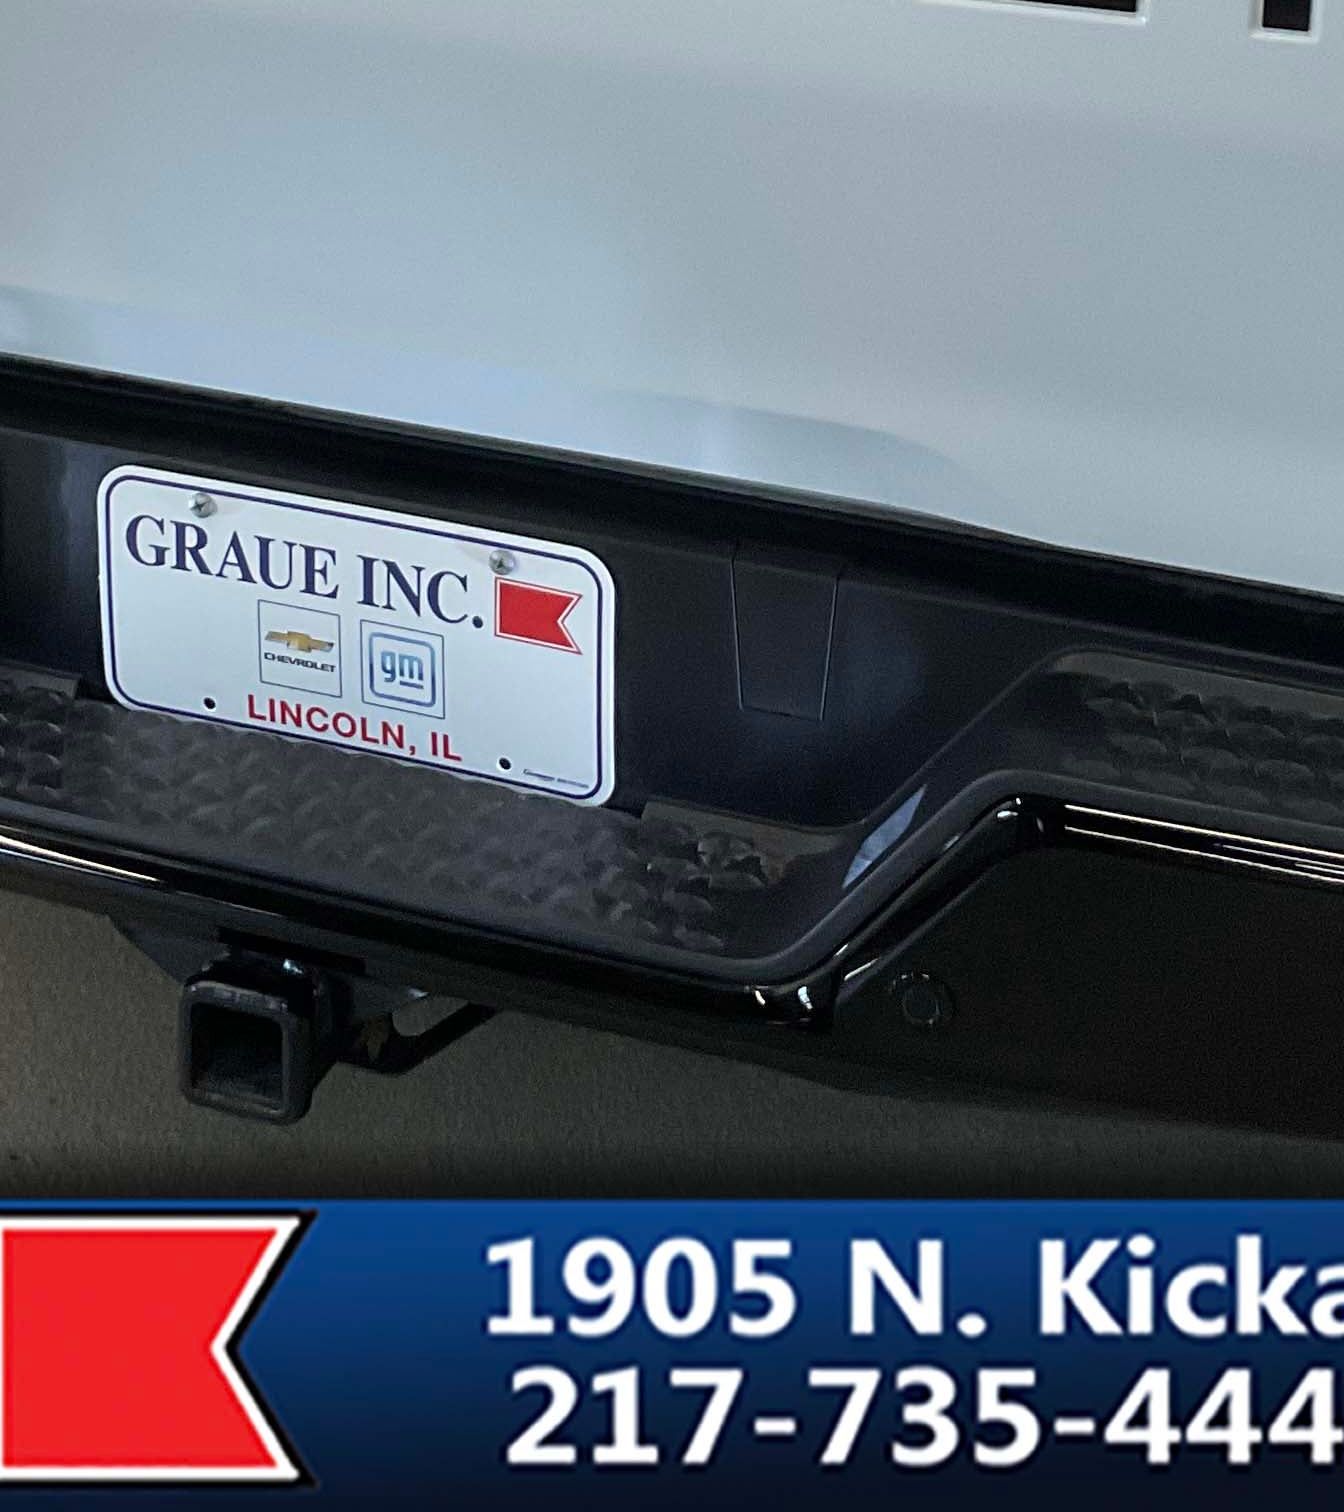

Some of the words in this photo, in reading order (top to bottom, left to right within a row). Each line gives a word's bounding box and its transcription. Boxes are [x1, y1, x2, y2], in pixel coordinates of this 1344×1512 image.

[125, 514, 340, 601] GRAUE
[356, 553, 485, 629] INC.
[263, 651, 337, 673] CHEVROLET
[381, 651, 424, 683] gm
[247, 694, 417, 757] LINCOLN,
[430, 731, 463, 763] IL
